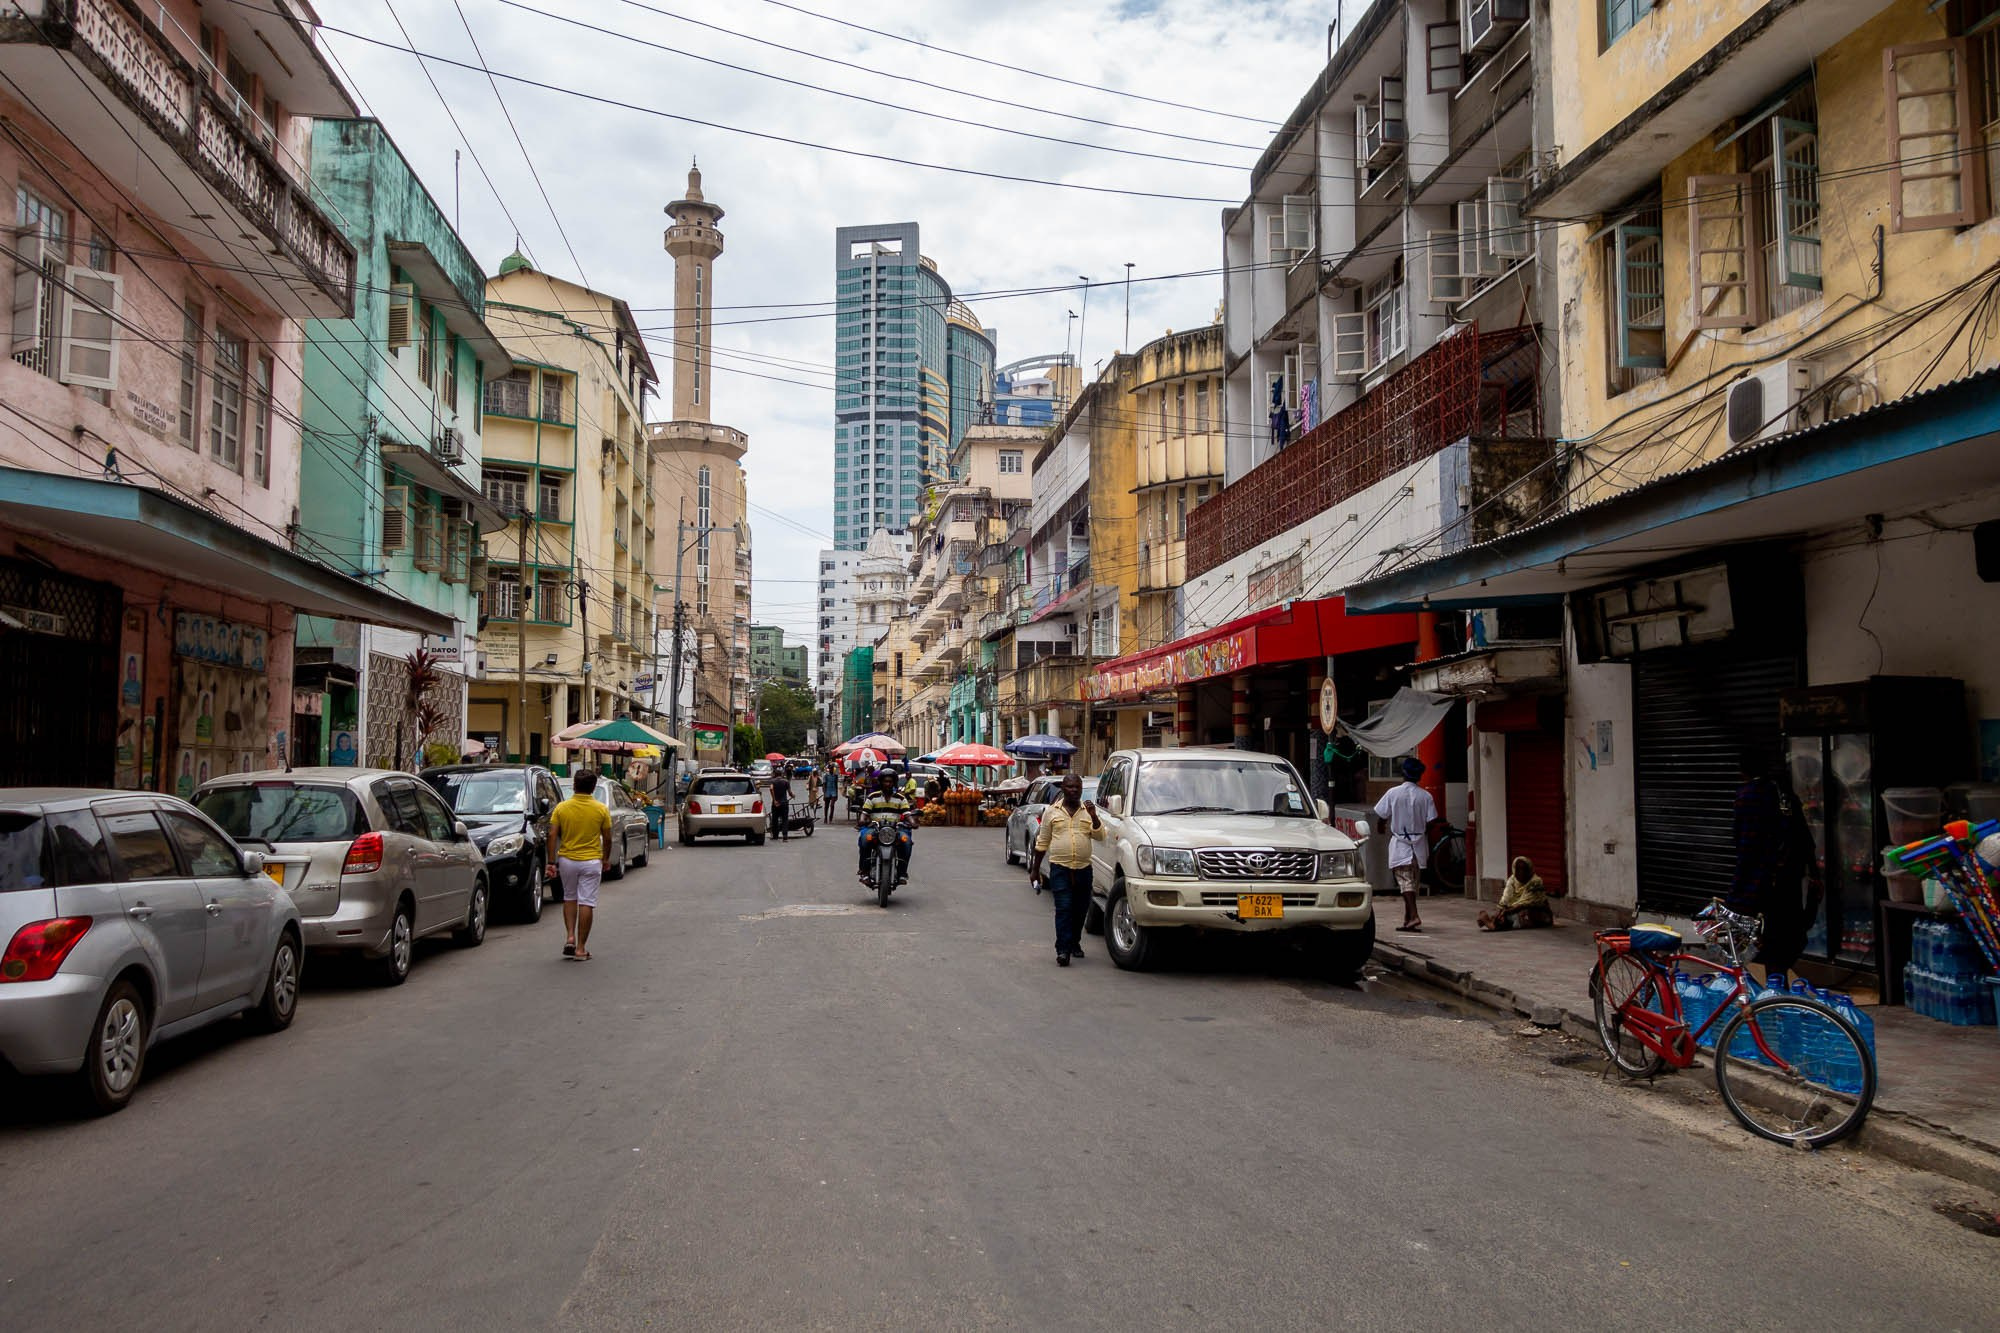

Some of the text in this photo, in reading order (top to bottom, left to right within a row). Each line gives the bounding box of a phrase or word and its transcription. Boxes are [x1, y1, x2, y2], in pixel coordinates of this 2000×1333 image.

[1248, 896, 1273, 906] T 622
[1254, 906, 1273, 917] BAX
